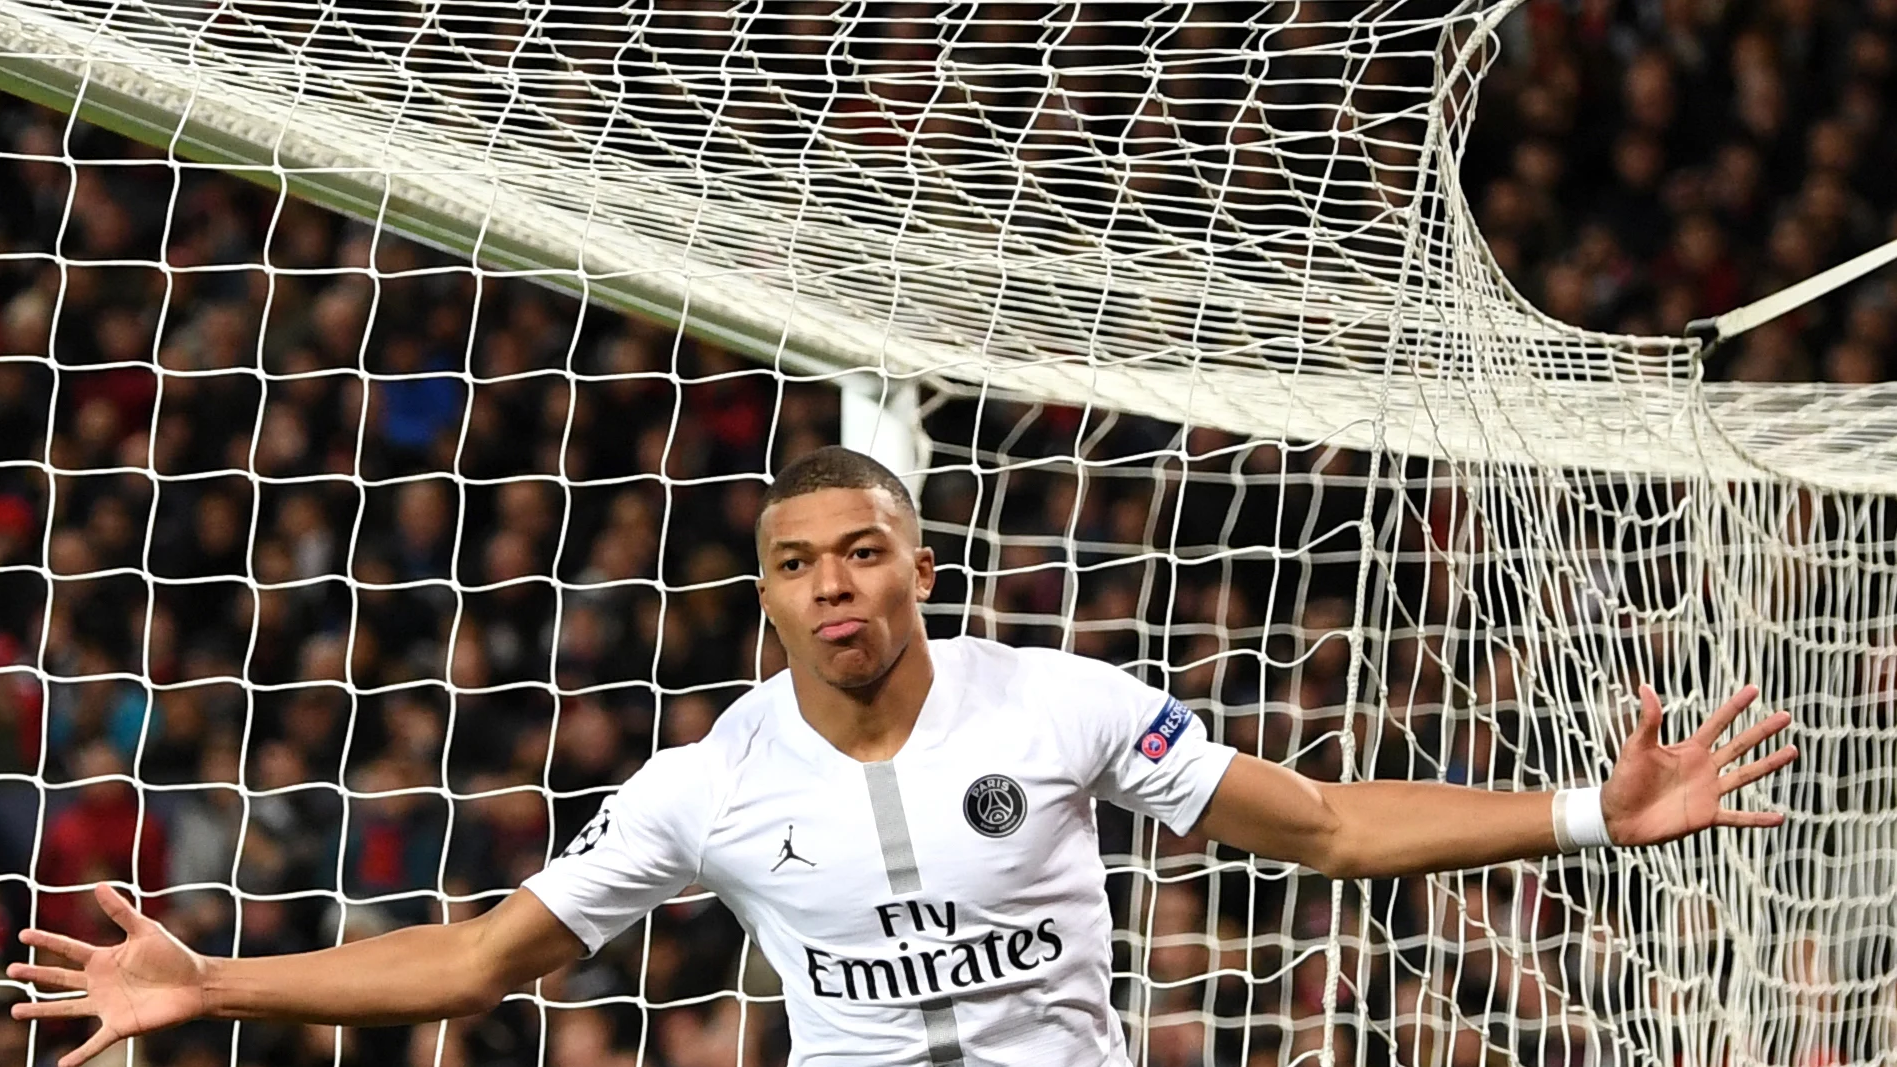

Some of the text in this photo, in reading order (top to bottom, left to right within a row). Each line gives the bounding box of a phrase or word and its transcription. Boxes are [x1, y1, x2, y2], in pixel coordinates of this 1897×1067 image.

[971, 779, 1010, 798] PARIS
[875, 899, 956, 937] Fly
[803, 918, 1063, 1000] Emirates
